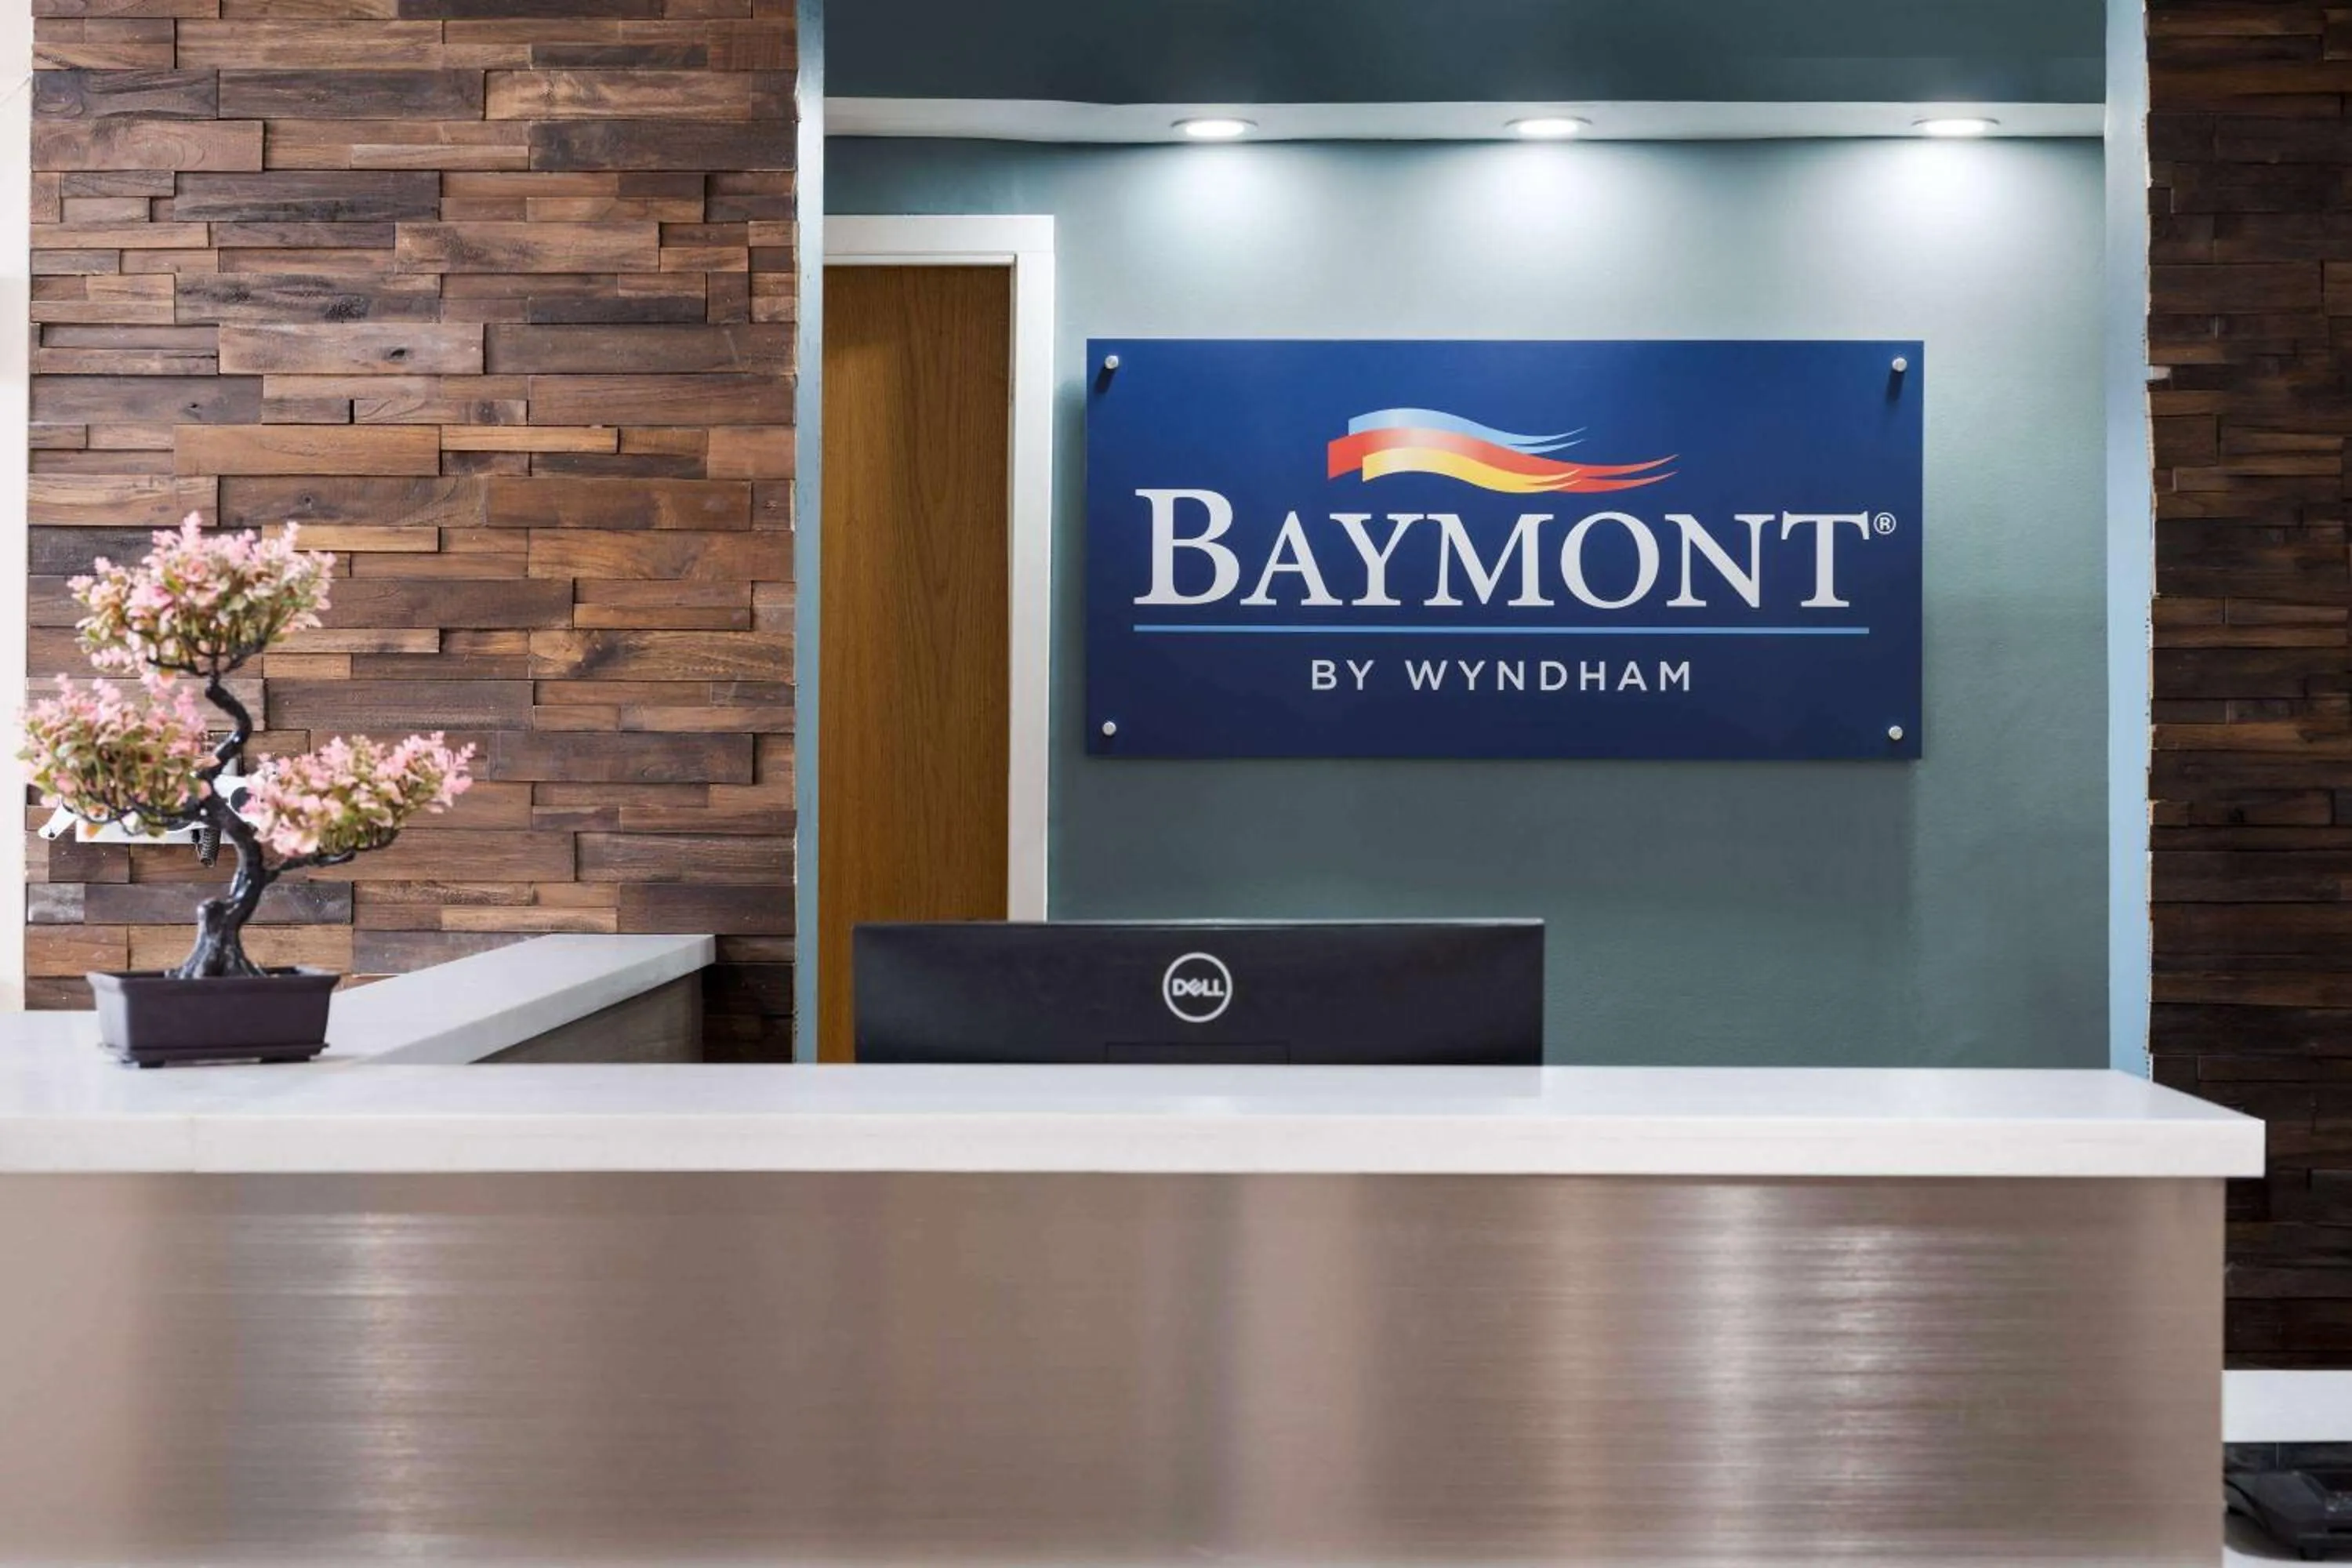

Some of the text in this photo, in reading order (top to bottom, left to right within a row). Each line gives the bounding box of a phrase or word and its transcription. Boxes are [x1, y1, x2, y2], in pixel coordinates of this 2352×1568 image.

[1311, 659, 1690, 691] BY WYNDHAM
[1172, 978, 1225, 996] DELL
